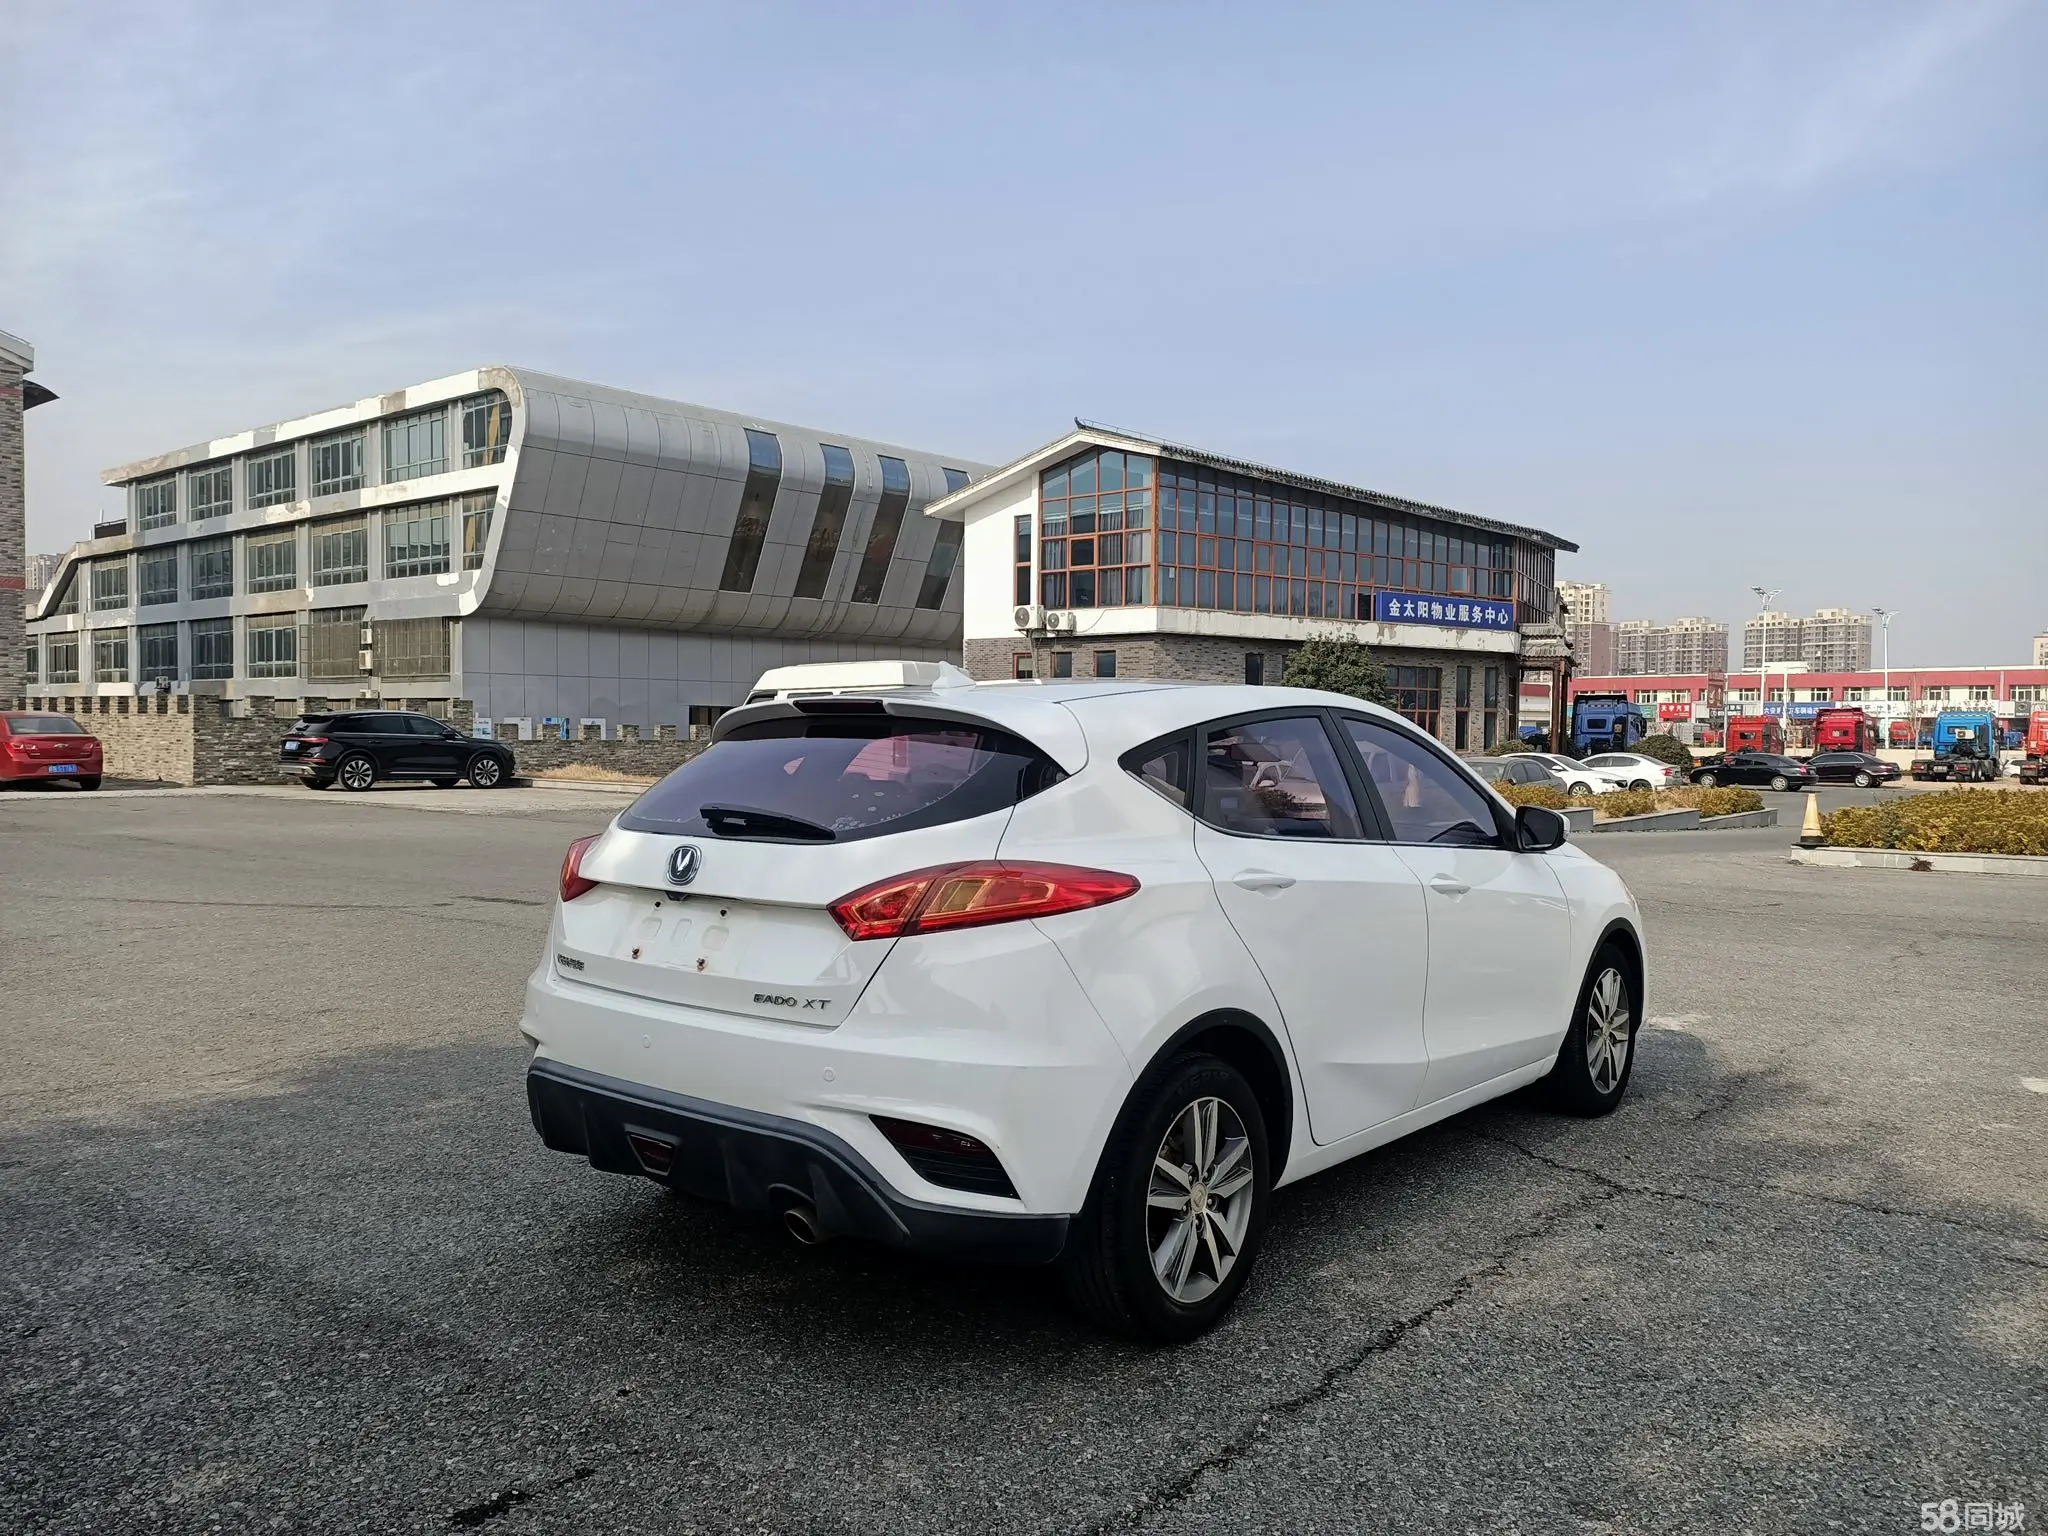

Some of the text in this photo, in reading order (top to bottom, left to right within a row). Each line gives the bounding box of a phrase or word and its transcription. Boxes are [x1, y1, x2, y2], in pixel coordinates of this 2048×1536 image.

[1388, 598, 1509, 624] 金太阳物业服务中心
[753, 993, 831, 1009] EADO XT
